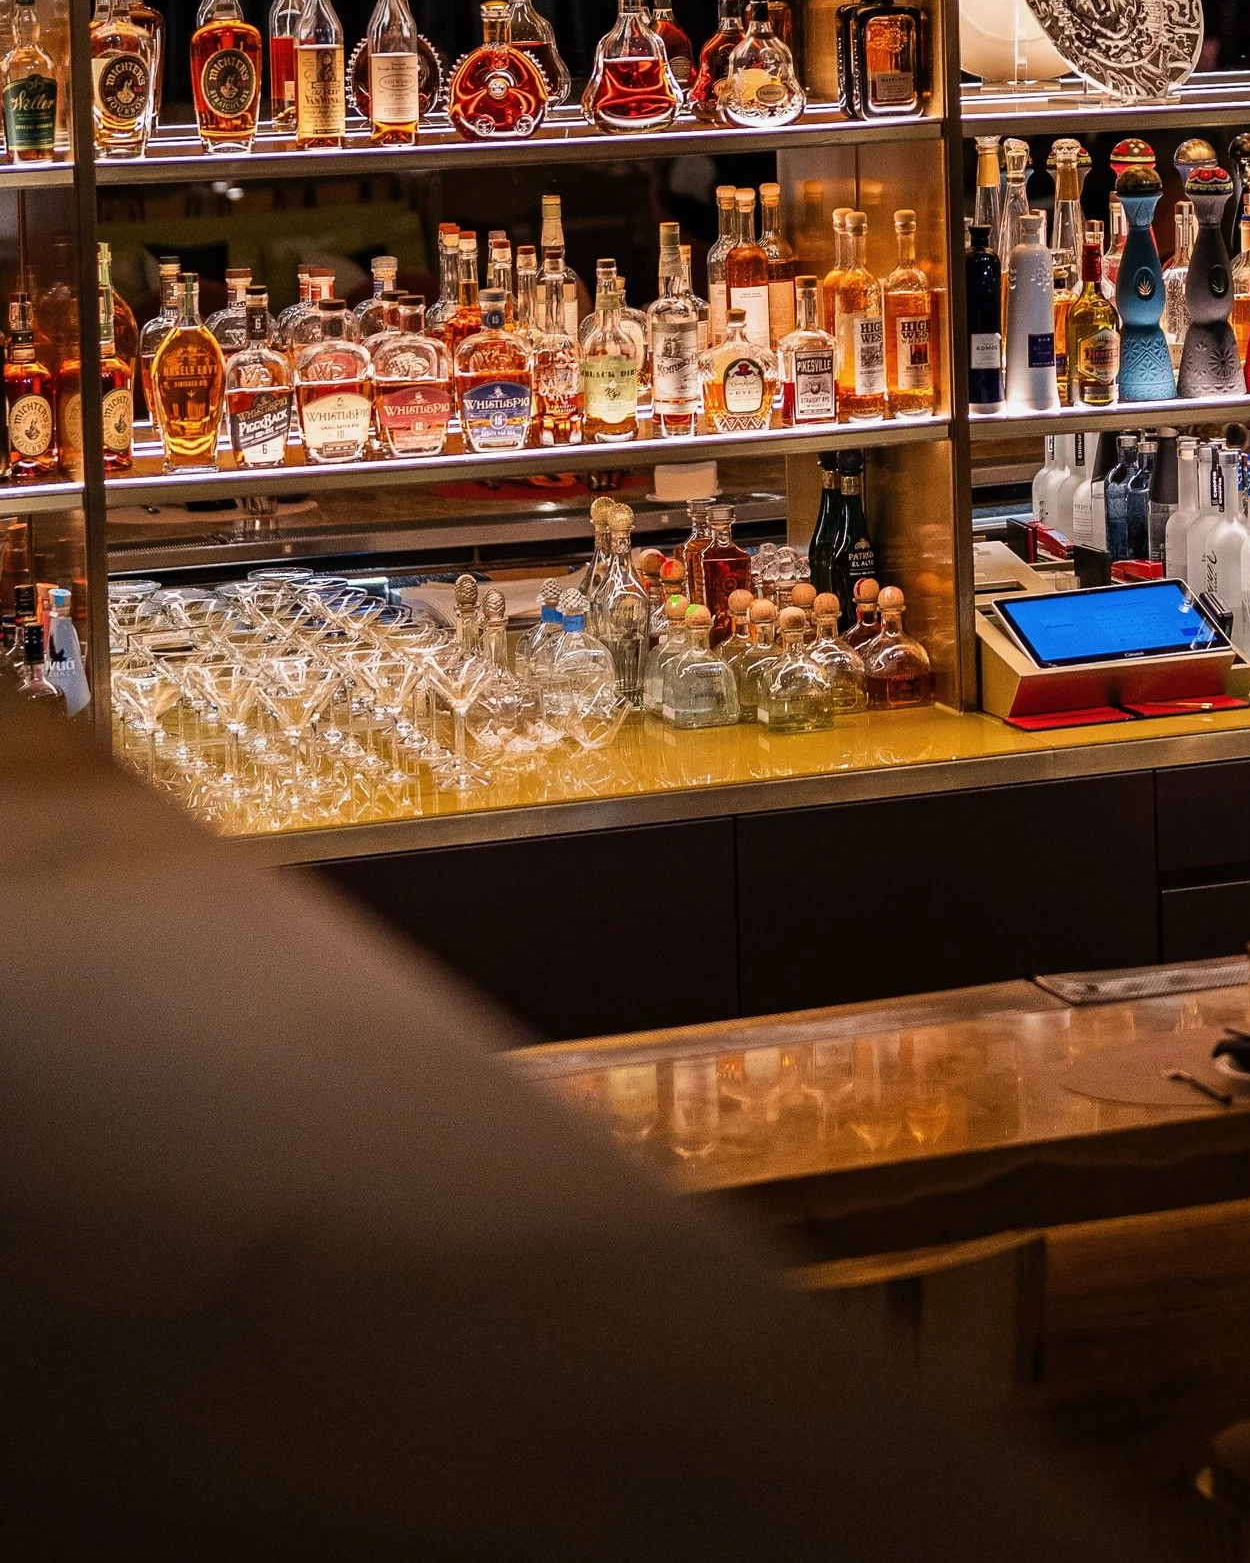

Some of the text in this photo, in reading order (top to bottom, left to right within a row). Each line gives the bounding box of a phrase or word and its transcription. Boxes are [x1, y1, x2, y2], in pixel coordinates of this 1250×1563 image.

[105, 61, 146, 87] MICHTER'S
[208, 56, 250, 82] MICHTER'S
[10, 90, 55, 112] Weller
[106, 95, 146, 115] BOURBON
[209, 89, 241, 111] STRAIGHT
[254, 318, 262, 330] 6
[490, 314, 500, 324] 15
[861, 333, 883, 344] WES
[796, 359, 832, 373] PIKESVILLE
[604, 388, 621, 400] Rye
[237, 396, 289, 422] WHISTLEPIG
[382, 402, 450, 417] WHISTLEPIG
[462, 397, 530, 411] WHISTLEPIG
[14, 401, 51, 425] MICHTER'S
[305, 408, 370, 423] WHISTLEPIG
[14, 431, 50, 452] BOURBON
[336, 430, 345, 439] 10
[262, 443, 268, 455] 6
